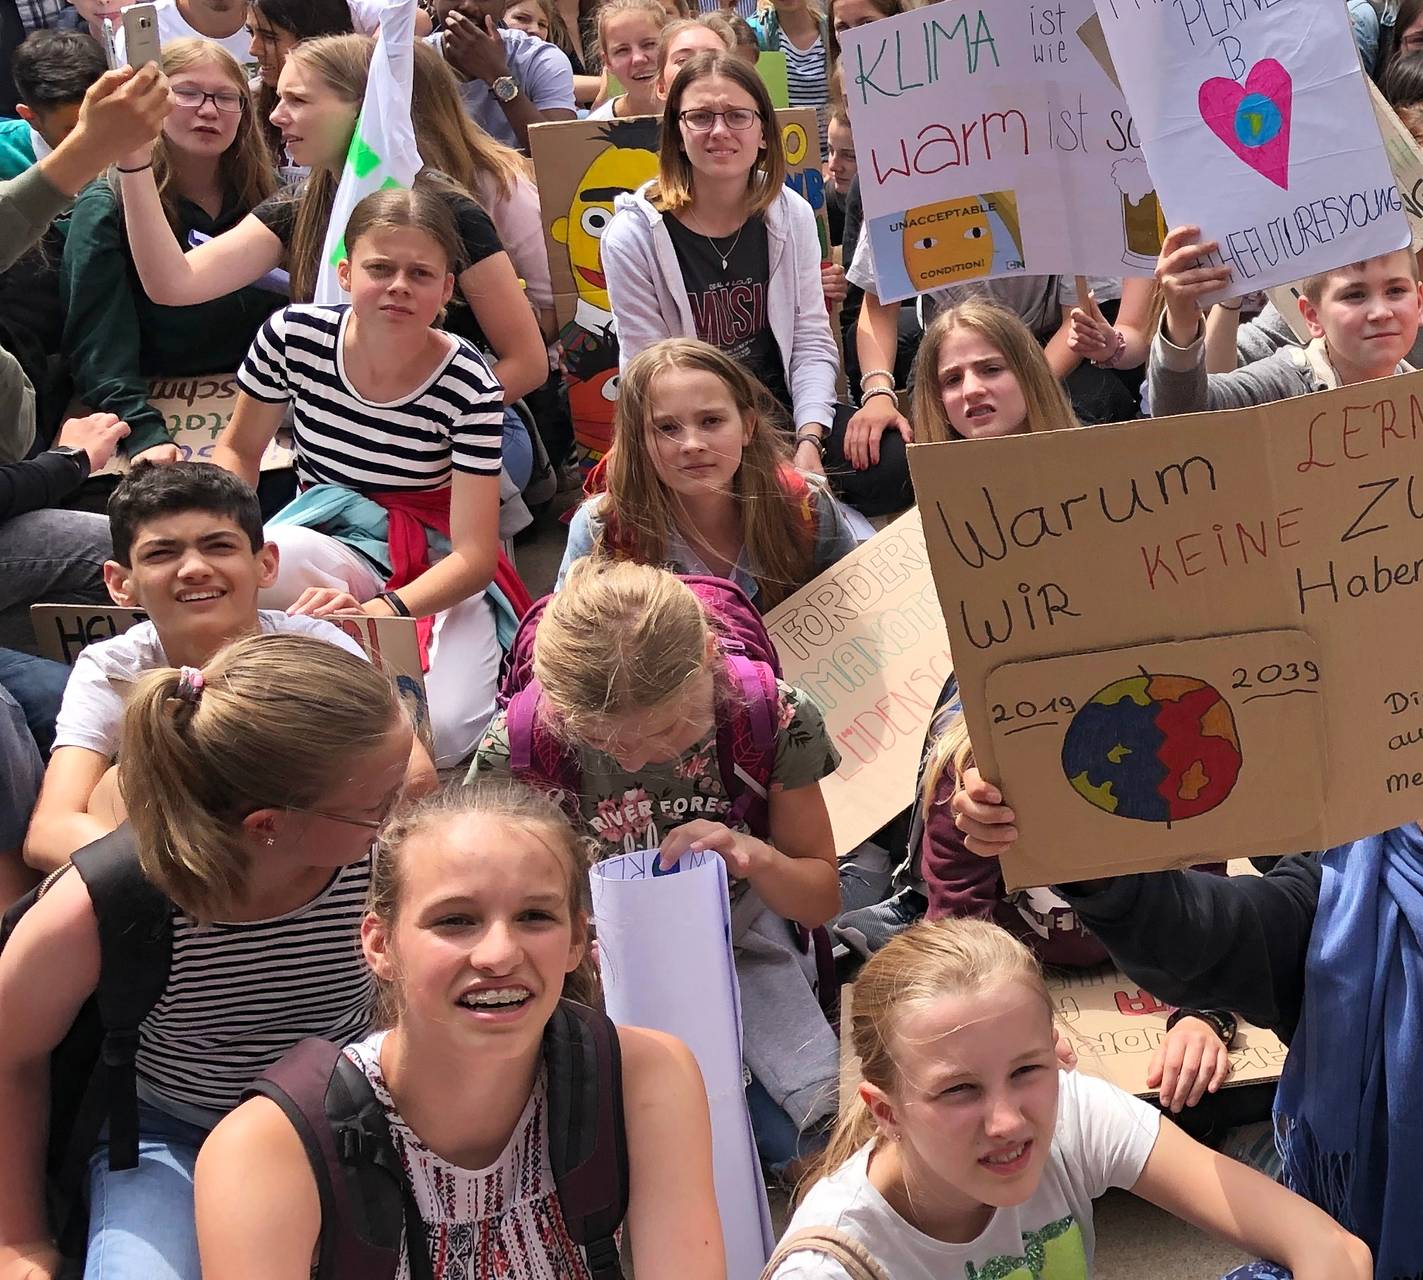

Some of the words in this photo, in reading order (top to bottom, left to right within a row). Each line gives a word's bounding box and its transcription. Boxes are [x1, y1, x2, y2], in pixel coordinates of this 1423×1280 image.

[1031, 5, 1066, 35] ist
[855, 10, 1000, 104] KLIMA
[1034, 40, 1068, 63] wie
[1219, 36, 1246, 81] B
[872, 109, 1029, 185] warm
[1048, 93, 1088, 153] ist
[889, 202, 998, 233] UNACCEPTABLE
[920, 258, 985, 280] CONDITION!
[687, 282, 769, 347] MUSI
[937, 456, 1217, 569] Warum
[992, 696, 1077, 724] 2019
[1232, 661, 1320, 688] 2039
[589, 800, 653, 833] RIVER
